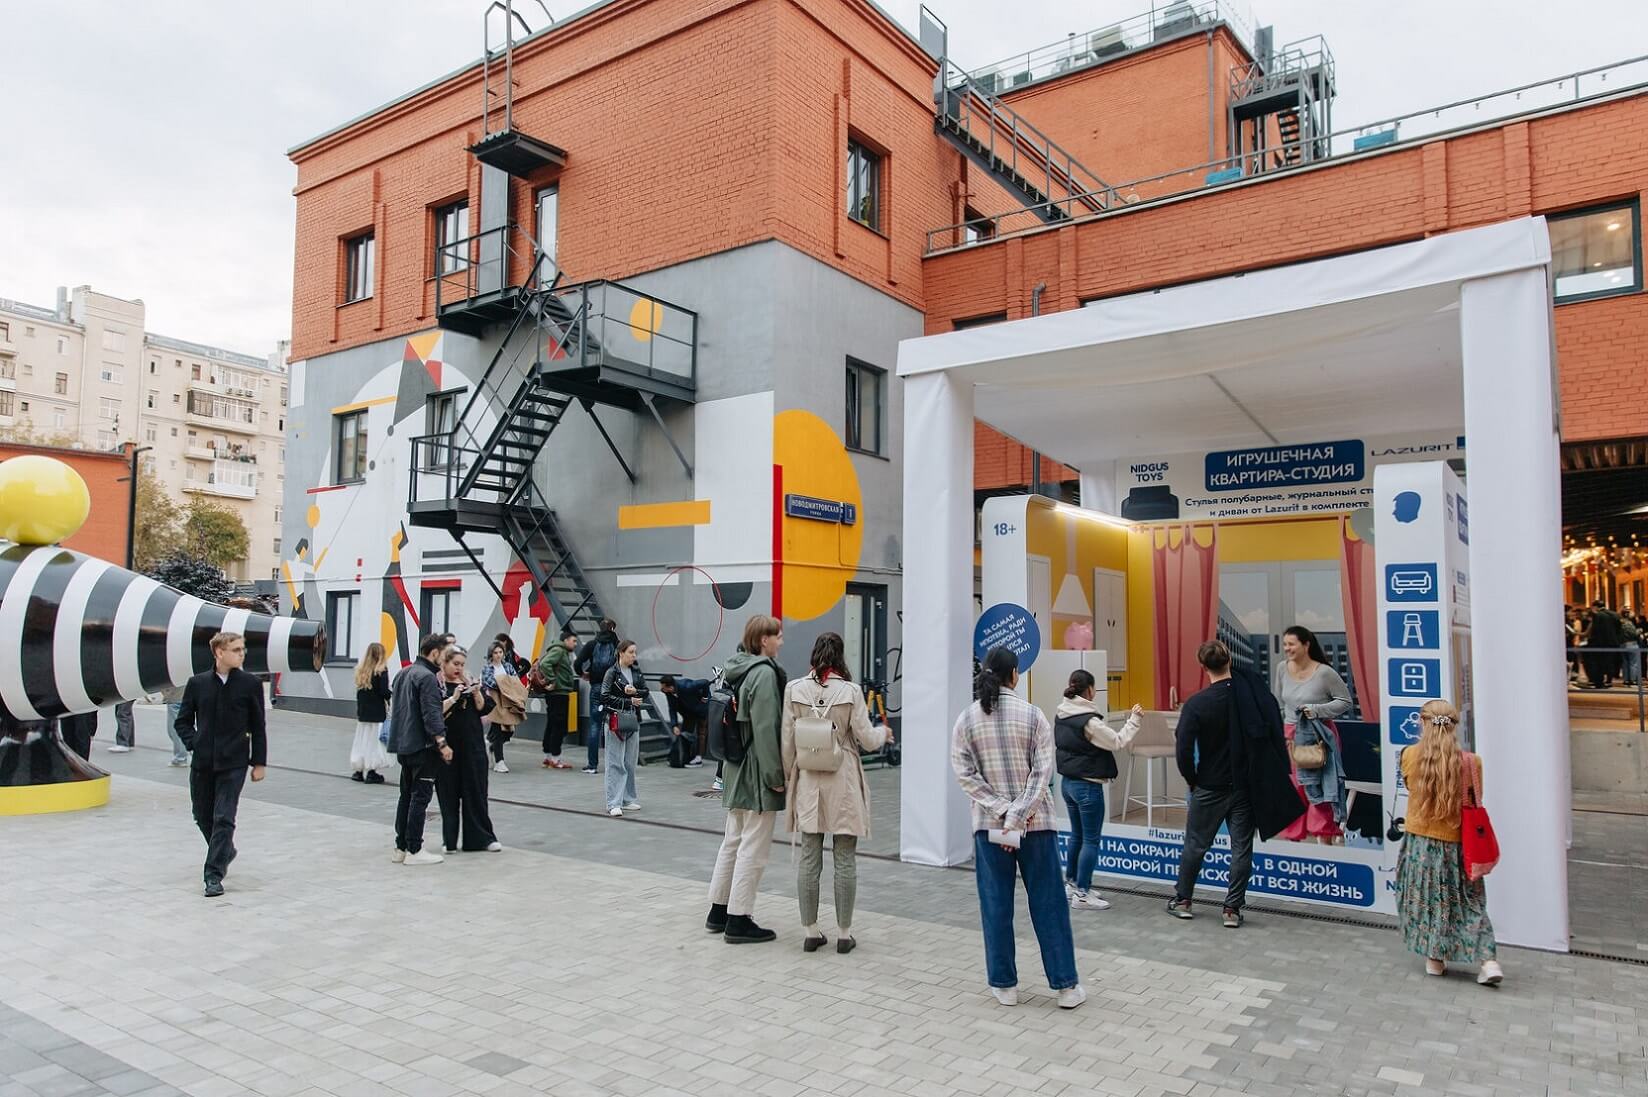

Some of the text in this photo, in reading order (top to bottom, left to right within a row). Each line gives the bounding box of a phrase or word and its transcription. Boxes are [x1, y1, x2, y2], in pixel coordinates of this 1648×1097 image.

[1226, 446, 1334, 467] ИГРУШЕЧНАЯ
[1371, 443, 1455, 457] LAZURIT
[1130, 462, 1169, 473] NIDGUS
[1210, 464, 1355, 486] КВАРТИРА-СТУДИЯ
[1136, 472, 1164, 482] TOYS
[1184, 498, 1218, 507] Стулья
[1221, 494, 1285, 505] полубарные,
[1288, 487, 1357, 500] журнальный
[1218, 508, 1249, 518] диван
[1265, 502, 1299, 513] Lazurit
[1311, 501, 1370, 511] комплекте
[993, 522, 1017, 536] 18+
[991, 614, 1015, 631] САМАЯ
[1008, 617, 1026, 631] РАДИ
[1015, 626, 1026, 636] ТЫ
[1107, 841, 1127, 854] НА
[1129, 843, 1183, 860] ОКРАИН
[1264, 858, 1274, 871] В
[1277, 860, 1338, 878] ОДНОЙ
[1098, 855, 1161, 874] КОТОРОЙ
[1267, 877, 1298, 891] ВСЯ
[1301, 880, 1364, 900] ЖИЗНЬ
